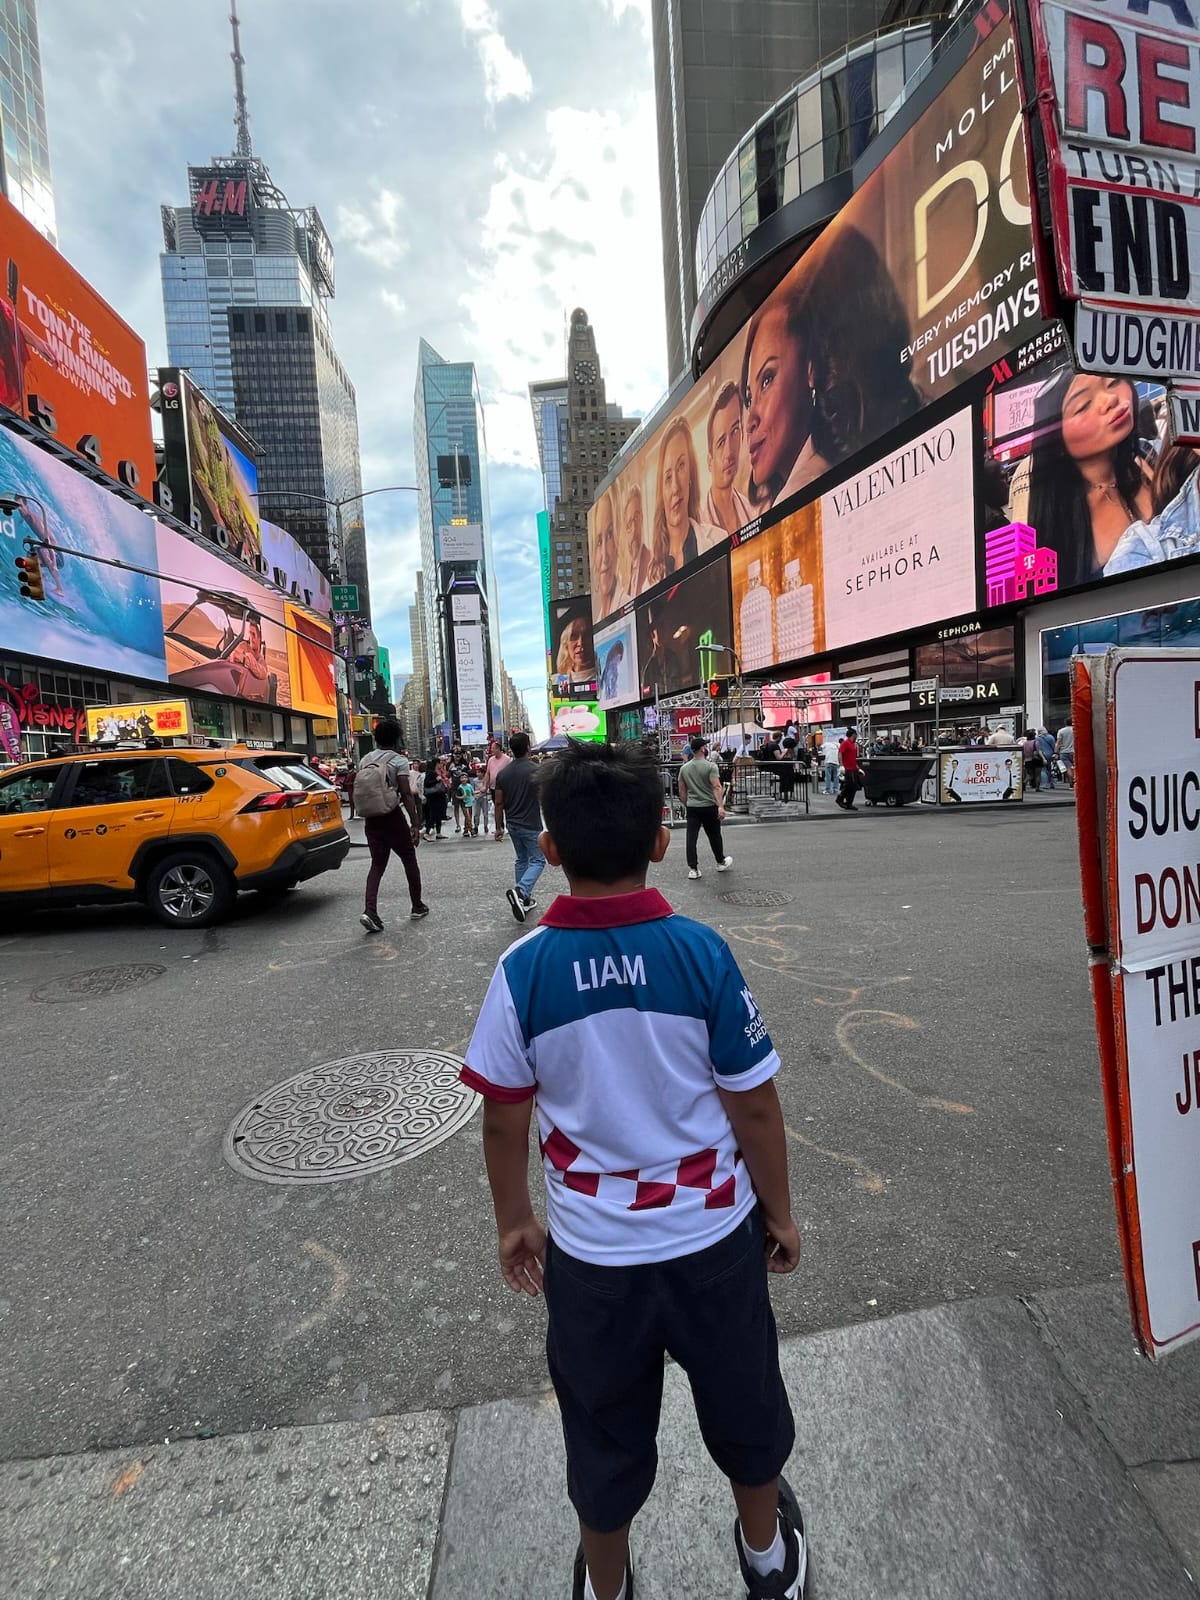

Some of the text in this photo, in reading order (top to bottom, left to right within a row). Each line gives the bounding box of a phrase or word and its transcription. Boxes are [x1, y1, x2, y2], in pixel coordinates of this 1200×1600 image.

[1064, 10, 1200, 154] RE
[935, 71, 1014, 163] MOLL
[1068, 144, 1181, 193] TURN
[195, 180, 247, 216] H&M
[1072, 186, 1190, 300] END
[22, 284, 73, 348] TONY
[68, 311, 92, 344] THE
[900, 320, 941, 364] EVERY
[945, 262, 1015, 329] MEMORY
[927, 278, 1040, 384] TUESDAYS
[32, 346, 92, 397] ADWAY
[45, 328, 117, 406] WINNING
[165, 400, 178, 409] LG
[832, 428, 955, 518] VALENTINO
[740, 517, 762, 536] MARRIOTT
[740, 526, 760, 543] MARQUIS
[861, 534, 919, 565] AVAILABLE AT
[845, 545, 941, 596] SEPHORA
[938, 621, 981, 639] SEPHORA
[967, 776, 996, 785] HEART
[1128, 771, 1200, 840] SUIC
[572, 954, 647, 992] LIAM
